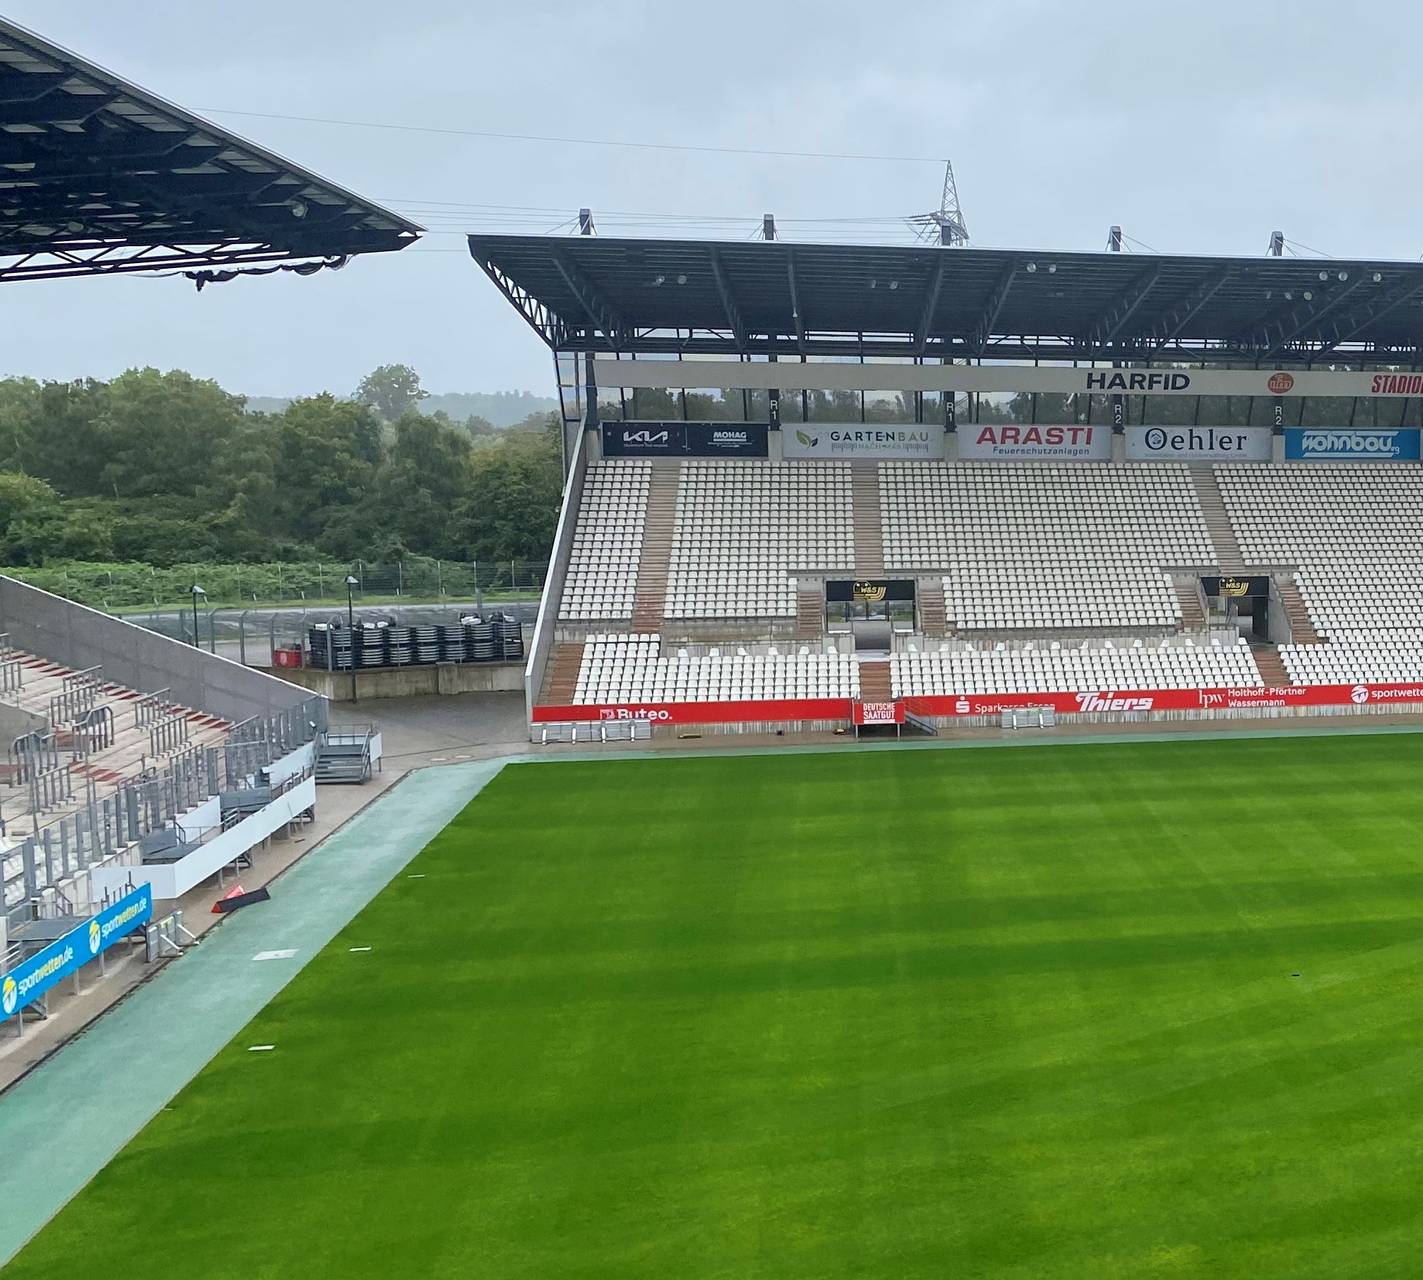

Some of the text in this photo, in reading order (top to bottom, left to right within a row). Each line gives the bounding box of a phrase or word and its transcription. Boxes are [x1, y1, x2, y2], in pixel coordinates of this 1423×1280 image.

[1086, 372, 1190, 391] HARFID
[623, 430, 668, 443] KIA
[713, 431, 747, 439] MOHAG
[830, 431, 929, 442] GARTENBAU
[976, 426, 1093, 445] ARASTI
[1144, 427, 1247, 451] Oehler
[993, 446, 1090, 456] Feuerschutzanlagen
[863, 702, 895, 711] DEUTSCHE
[1075, 691, 1154, 712] Thiers
[1228, 698, 1285, 707] Wassermann
[863, 710, 895, 719] SAATGUT
[101, 896, 147, 939] sportwetten.de
[18, 945, 74, 996] sportwetten.de
